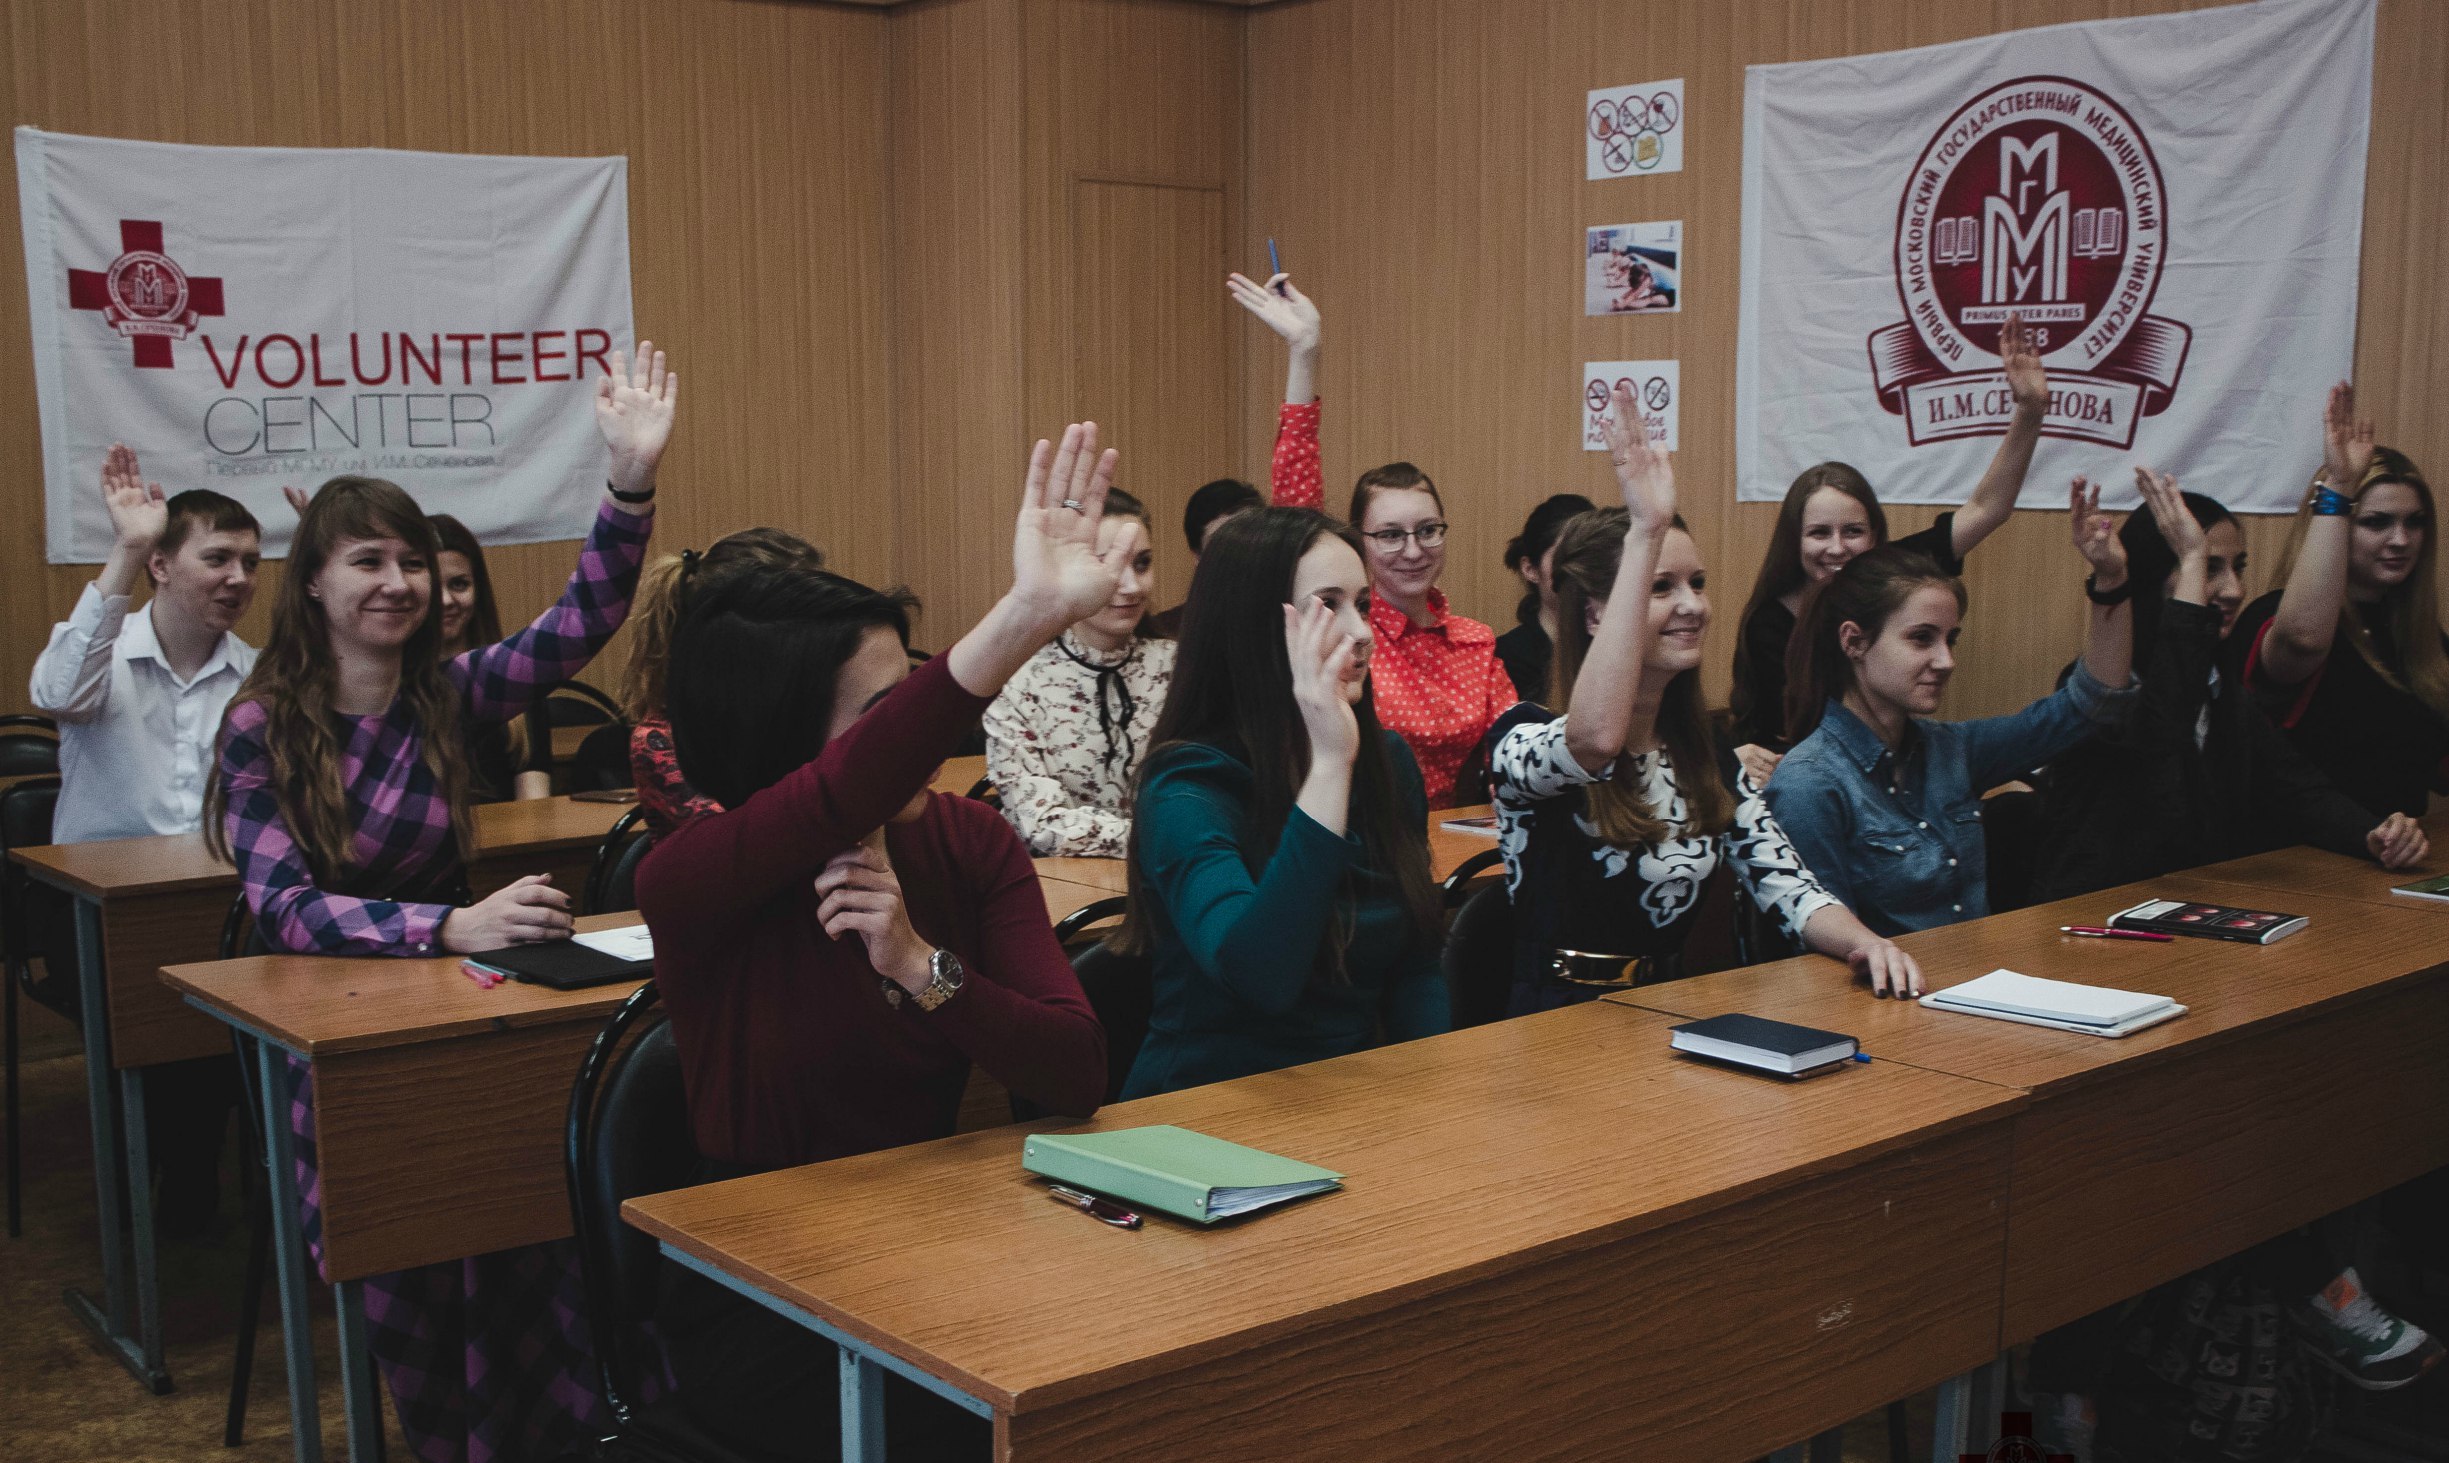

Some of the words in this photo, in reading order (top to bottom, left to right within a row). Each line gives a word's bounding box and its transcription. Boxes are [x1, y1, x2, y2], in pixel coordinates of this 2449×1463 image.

[1936, 91, 2082, 167] ГОСУДАРСТВЕННЫЙ
[2083, 106, 2158, 231] МЕДИЦИНСКИЙ
[1907, 169, 1942, 294] МОСКОВСКИЙ
[1915, 299, 1964, 361] ПЕРВЫЙ
[1965, 309, 2007, 321] PRIMUS
[2046, 307, 2081, 318] PARES
[2083, 242, 2154, 359] УНИВЕРСИТЕТ
[201, 328, 613, 389] VOLUNTEER
[203, 392, 496, 456] CENTER
[1928, 389, 2114, 425] И.М.СЕНОВА
